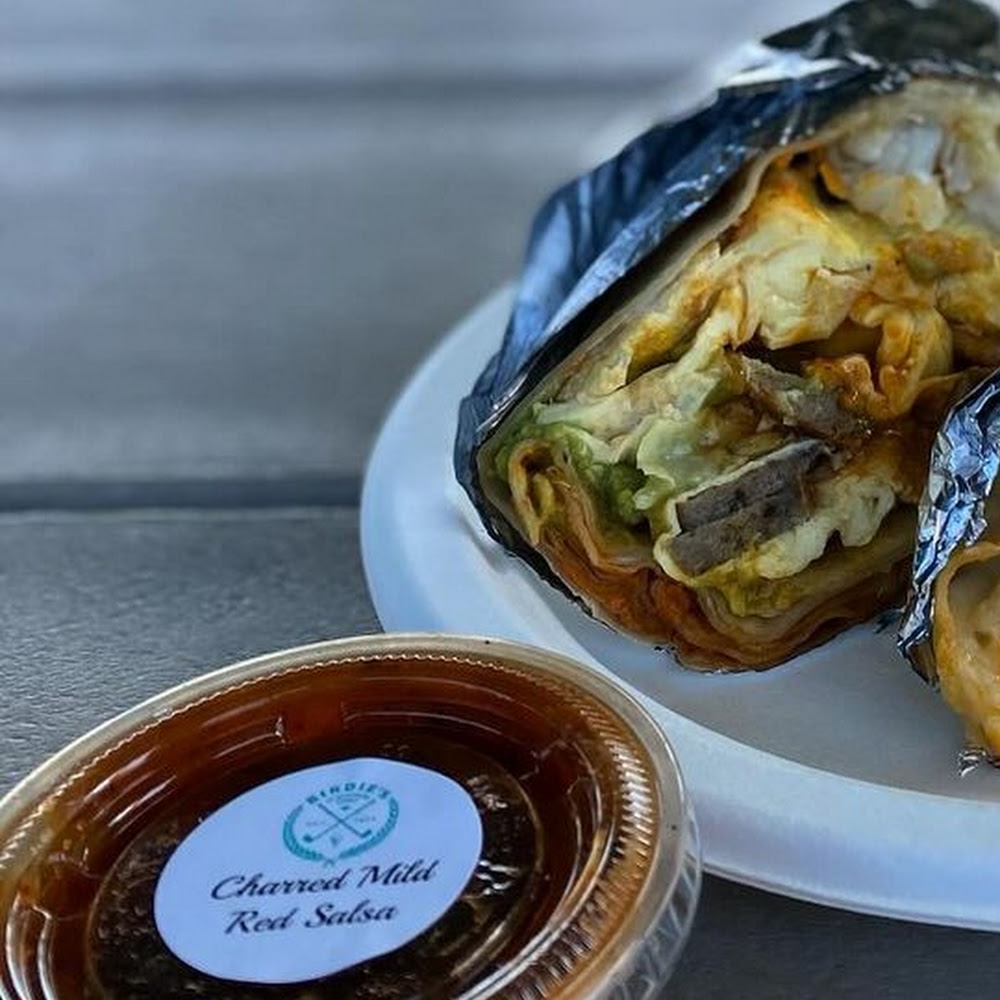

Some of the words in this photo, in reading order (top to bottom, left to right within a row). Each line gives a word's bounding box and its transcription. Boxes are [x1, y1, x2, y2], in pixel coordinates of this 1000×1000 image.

[211, 869, 351, 900] Charred
[357, 859, 440, 888] Mild
[225, 907, 299, 934] Red
[304, 899, 398, 928] Salsa
